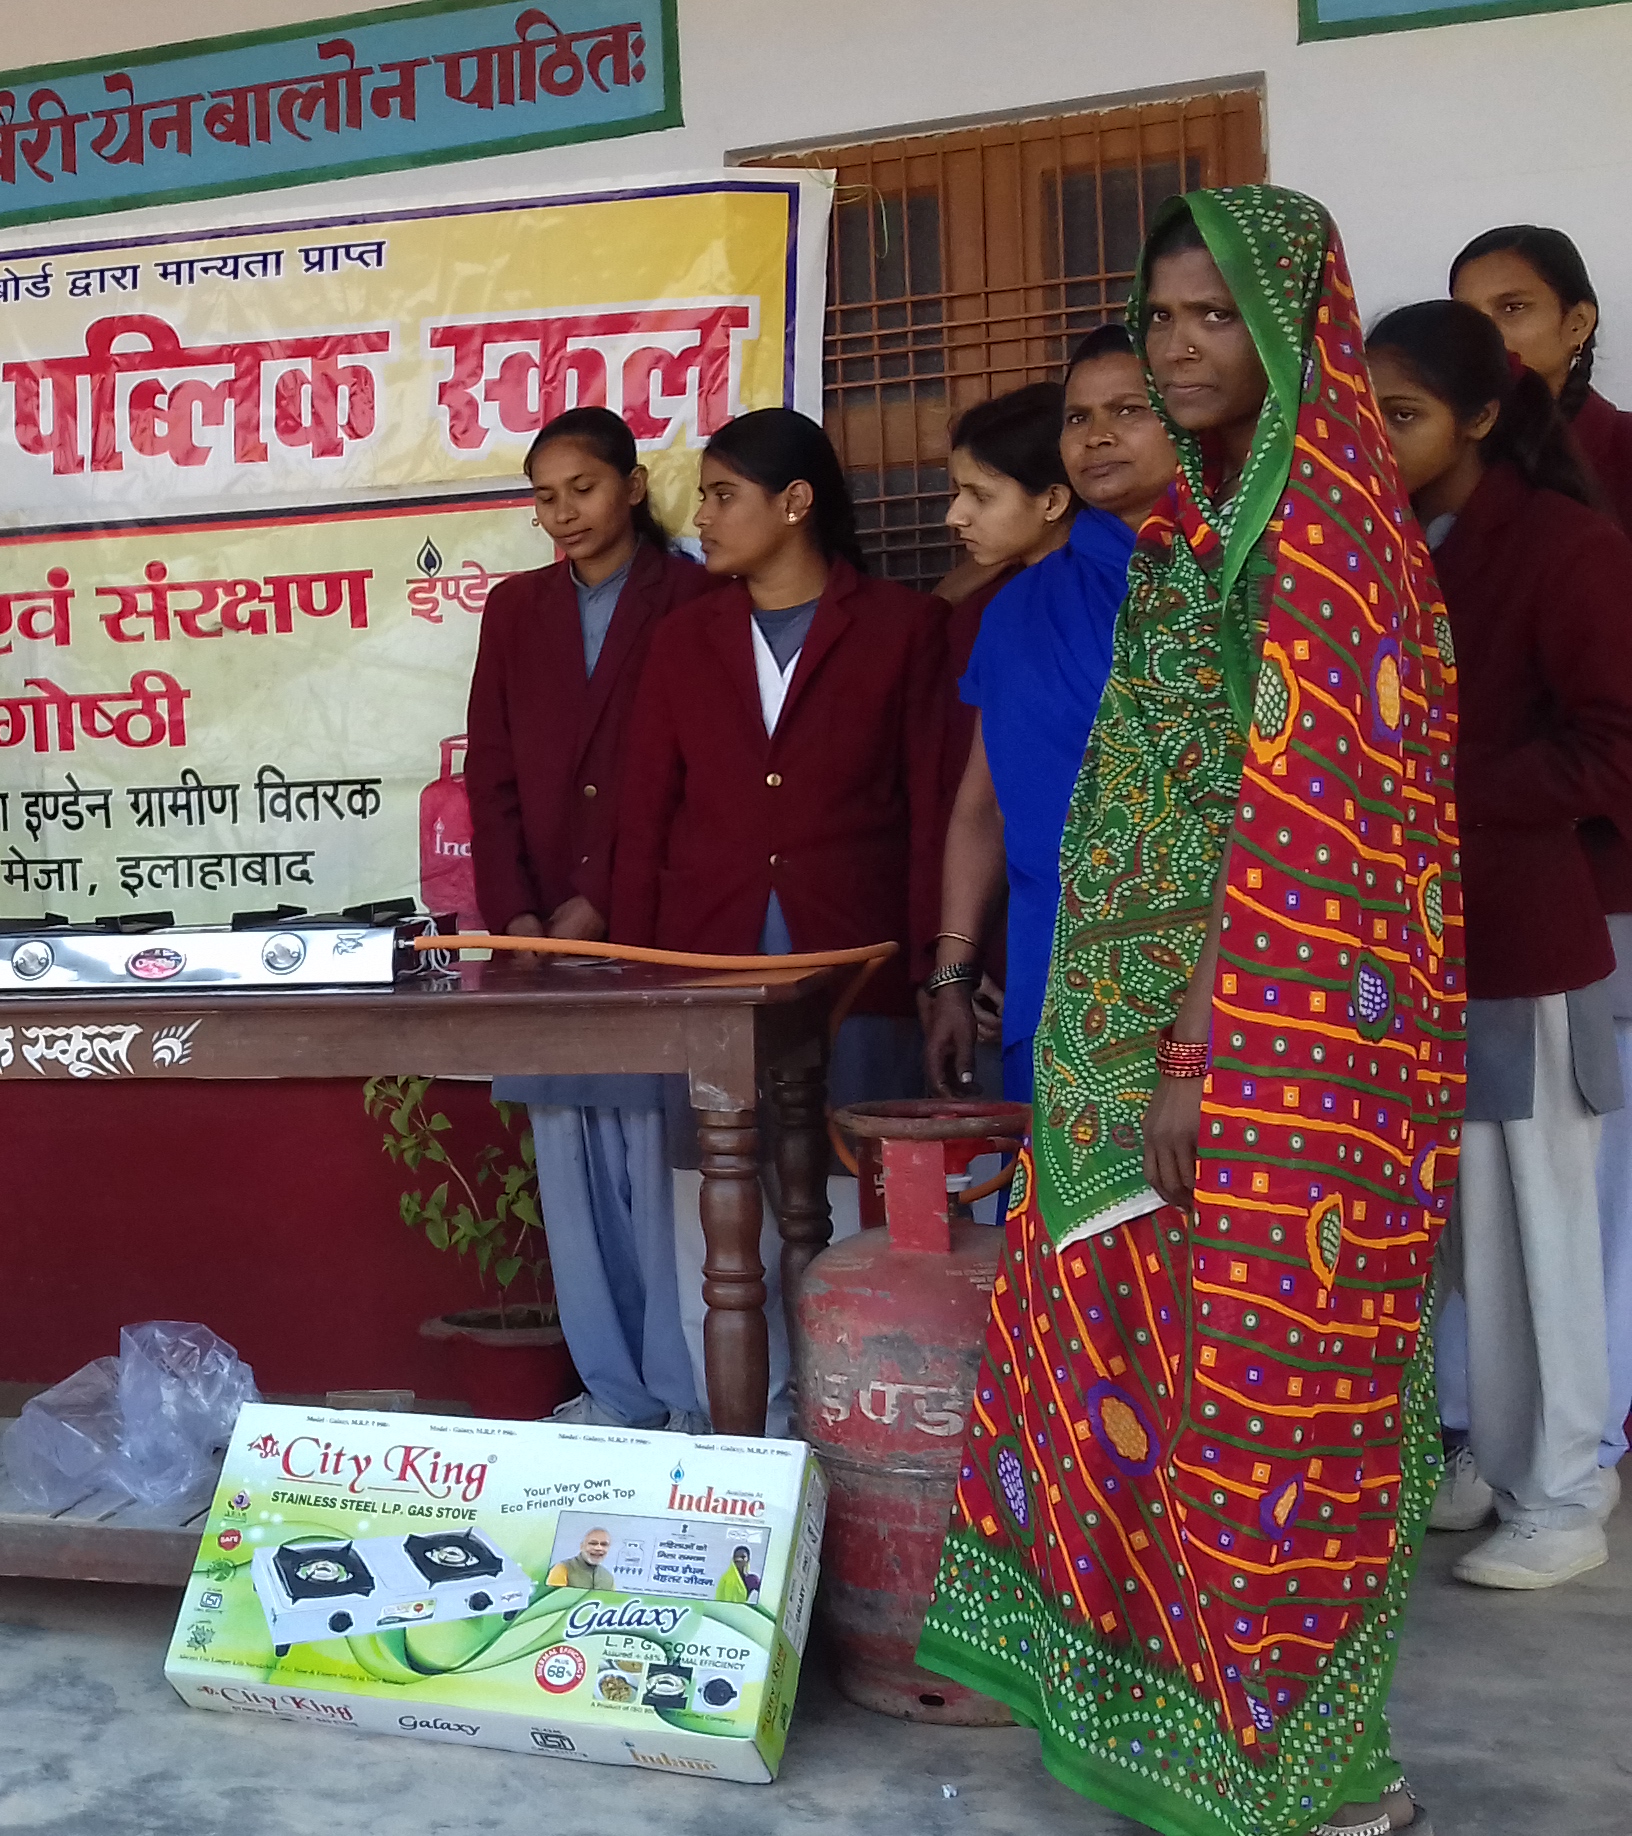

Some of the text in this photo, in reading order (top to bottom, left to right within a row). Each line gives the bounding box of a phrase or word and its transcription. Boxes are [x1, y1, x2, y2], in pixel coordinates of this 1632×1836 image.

[67, 264, 140, 298] द्वारा
[154, 248, 284, 286] मान्यता
[297, 240, 388, 274] प्राप्त
[1, 312, 391, 477] पब्लिक
[96, 559, 374, 644] संरक्षण
[20, 771, 113, 842] इण्डेन
[127, 767, 239, 829] ग्रामीण
[253, 765, 383, 824] वितरक
[117, 850, 316, 898] इलाहाबाद
[21, 1023, 144, 1078] स्कूल
[281, 1436, 372, 1494] City
[384, 1444, 488, 1503] King
[523, 1478, 611, 1498] Your Very Own
[271, 1490, 477, 1521] STAINLESS STEEL L.P. GAS STOVE
[501, 1488, 636, 1514] Eco Friendly Cook Top
[667, 1483, 766, 1518] Indane
[220, 1535, 239, 1543] SAFE
[565, 1600, 689, 1639] Galaxy
[663, 1640, 712, 1658] COOK
[716, 1646, 751, 1661] TOP
[220, 1686, 279, 1710] City
[280, 1694, 354, 1721] King
[398, 1715, 481, 1737] Galaxy
